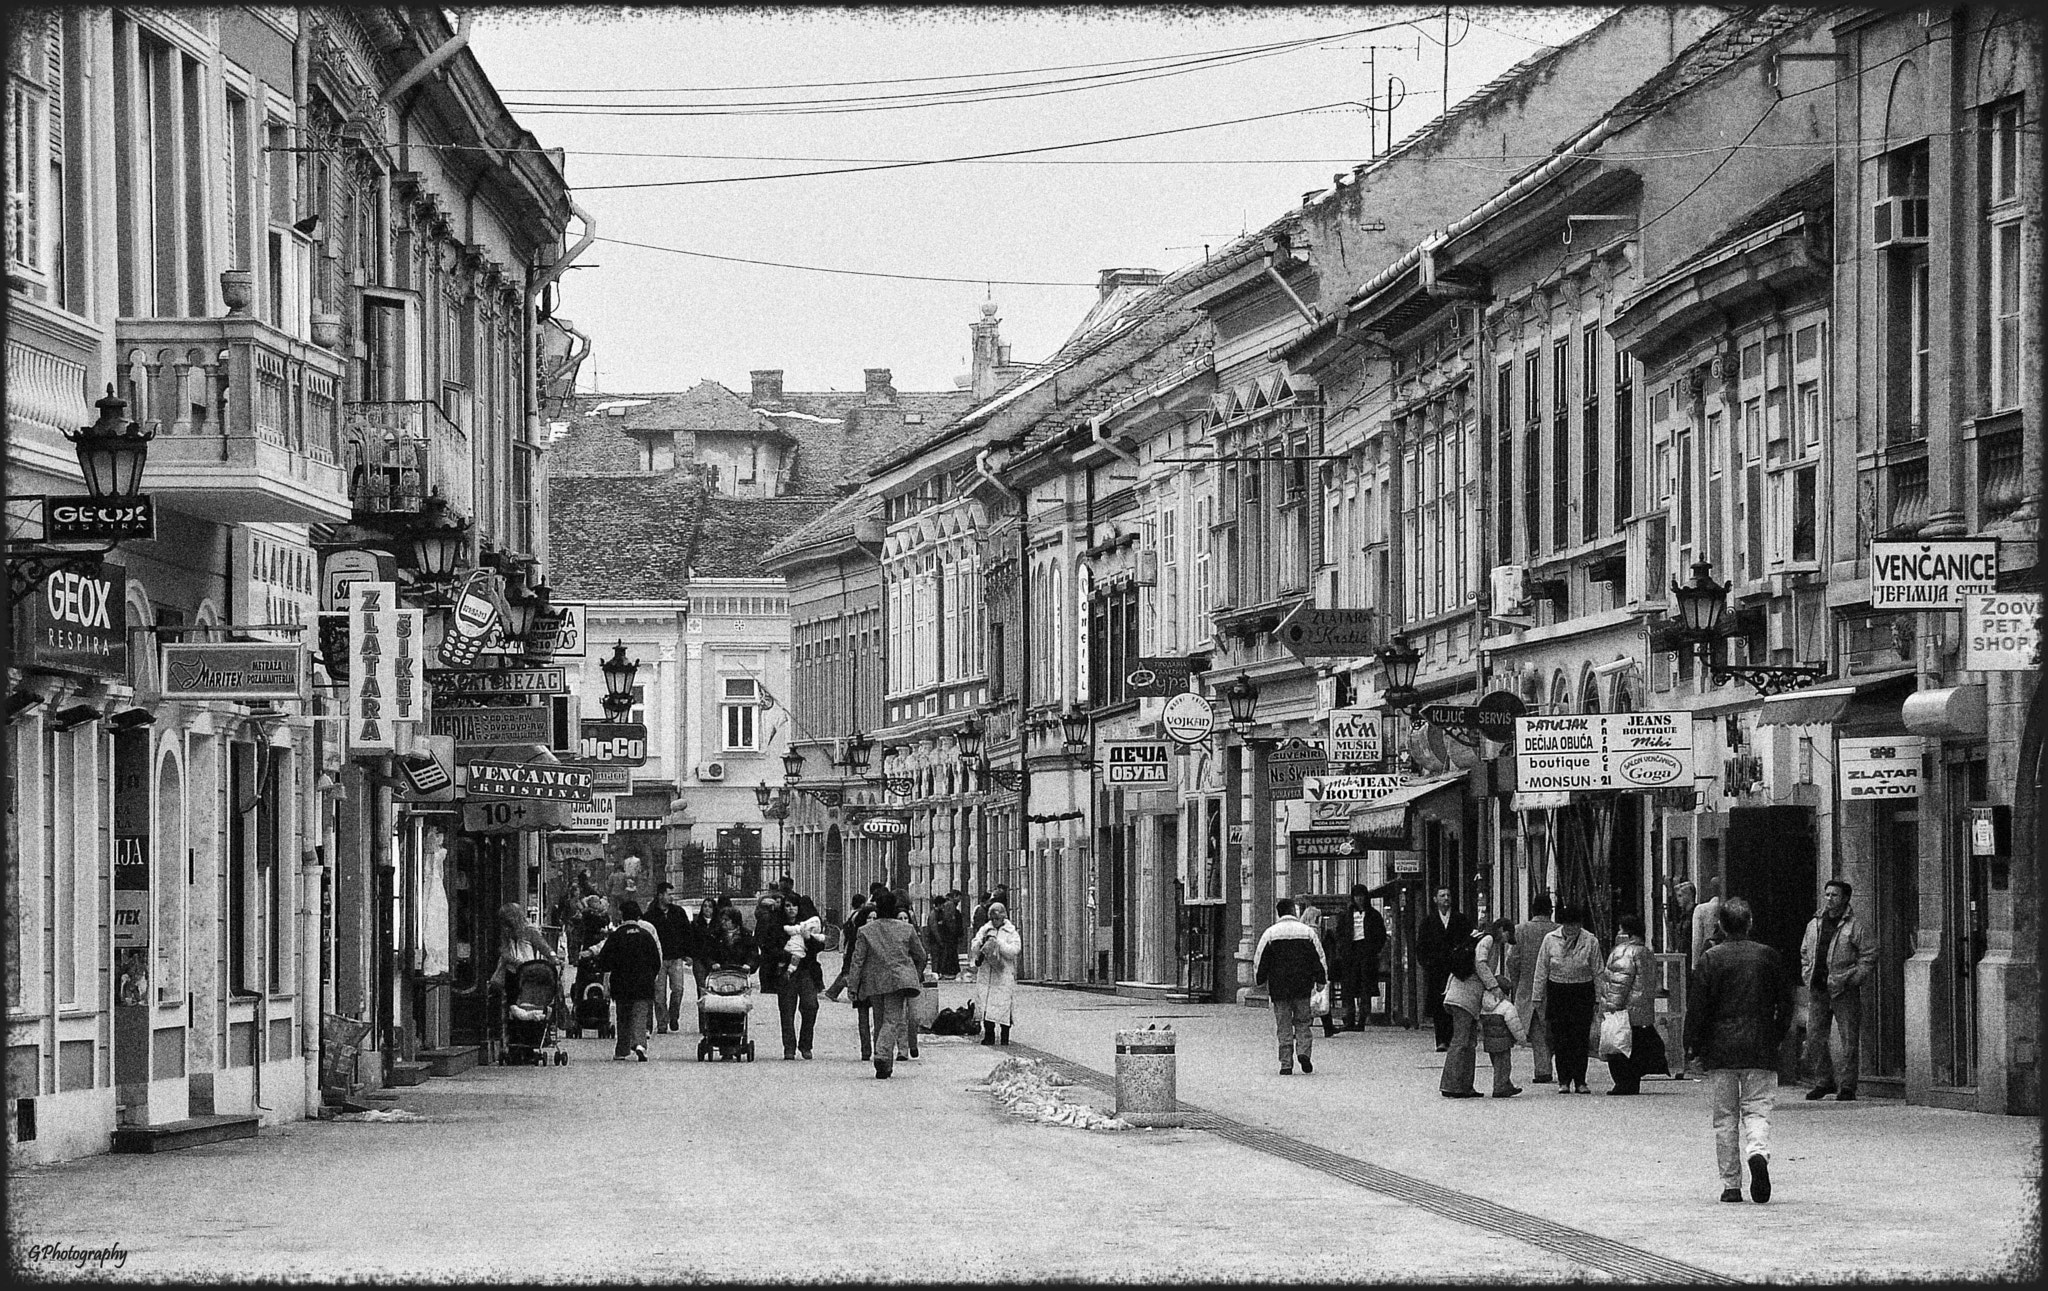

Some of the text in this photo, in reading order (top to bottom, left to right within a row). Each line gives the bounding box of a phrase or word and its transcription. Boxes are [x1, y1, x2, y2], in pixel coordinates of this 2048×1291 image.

[253, 537, 312, 596] ZLATARA
[1875, 545, 1995, 581] VENČANICE
[48, 570, 111, 629] GEOX
[49, 628, 110, 656] RESPIRA
[1973, 637, 2028, 651] SHOP
[360, 590, 382, 742] ZLATARA
[201, 668, 243, 688] MARITEX
[1479, 711, 1512, 725] SERVIS
[1627, 715, 1672, 726] JEANS
[1623, 727, 1677, 735] BOUTIQUE
[1336, 740, 1376, 750] MUŠKI
[1630, 736, 1672, 747] Miki
[1273, 751, 1321, 760] SUVENIRI
[1334, 750, 1379, 760] FRIZER
[1530, 756, 1590, 770] boutique
[470, 763, 591, 788] VENČANICE
[1270, 767, 1285, 783] Ns
[1600, 775, 1611, 785] 21
[1629, 768, 1671, 781] Goga
[1848, 768, 1917, 780] ZLATAR
[1529, 775, 1591, 788] MONSUN
[480, 783, 580, 799] KRISTINA
[863, 822, 908, 834] COTTON
